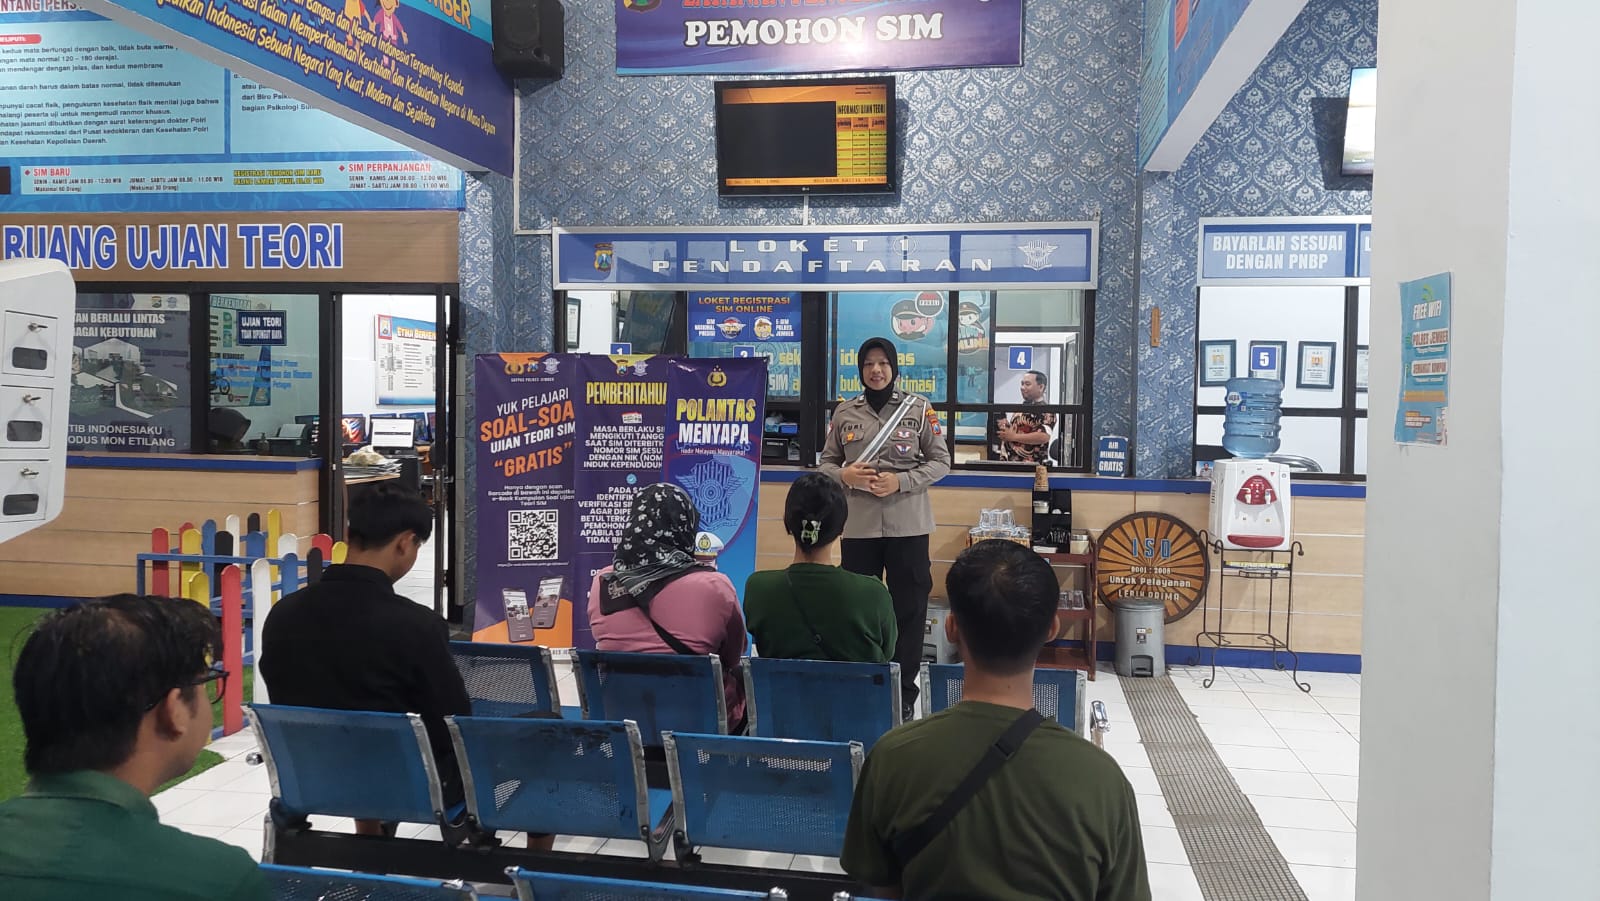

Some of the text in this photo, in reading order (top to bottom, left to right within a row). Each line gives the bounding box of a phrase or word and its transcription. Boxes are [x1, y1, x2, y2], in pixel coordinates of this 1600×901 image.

[684, 13, 944, 47] PEMOHON SIM
[260, 0, 288, 27] dalam
[289, 12, 357, 62] Mempertahankan
[358, 49, 391, 80] Keutuhan
[392, 67, 405, 89] dan
[336, 9, 350, 31] dan
[351, 19, 378, 47] Negara
[378, 34, 410, 66] Indonesia
[410, 53, 443, 89] Tergantung
[444, 71, 464, 96] Kepada
[206, 4, 257, 42] Indonesia
[257, 27, 292, 60] Sebuah
[294, 45, 323, 74] Negara
[325, 58, 343, 89] Yang
[344, 69, 366, 98] Kuat,
[365, 81, 392, 107] Modern
[392, 93, 405, 113] dan
[405, 101, 436, 129] Sejahtera
[33, 167, 70, 176] SIM BARU
[348, 163, 431, 172] SIM PERPANJANGAN
[3, 222, 343, 270] RUANG UJIAN TEORI
[730, 239, 869, 254] LOKET
[1212, 234, 1343, 252] BAYARLAH SESUAI
[652, 256, 993, 274] PENDAFTARAN
[1226, 253, 1328, 270] DENGAN PNBP
[698, 297, 790, 305] LOKET REGISTRASI
[715, 305, 773, 313] SIM ONLINE
[90, 312, 165, 324] BERLALU LINTAS
[241, 316, 282, 327] UJIAN TEORI
[99, 327, 157, 338] KEBUTUHAN
[1016, 351, 1026, 366] 4
[1259, 352, 1270, 367] 5
[496, 387, 569, 417] YUK PELAJARI
[675, 398, 757, 422] POLANTAS
[88, 425, 162, 435] INDONESIAKU
[590, 432, 634, 440] MENGIKUTI
[593, 425, 654, 433] MASA BERLAKU
[678, 423, 749, 445] MENYAPA
[100, 437, 126, 445] MON
[128, 438, 175, 447] ETILANG
[490, 421, 576, 454] UJIAN TEORI SIM
[593, 446, 625, 454] NOMOR
[1099, 450, 1125, 459] MINERAL
[1098, 460, 1124, 472] GRATIS
[608, 486, 632, 494] PADA
[1132, 538, 1171, 559] ISO
[1109, 575, 1191, 588] Untuk Pelayanan
